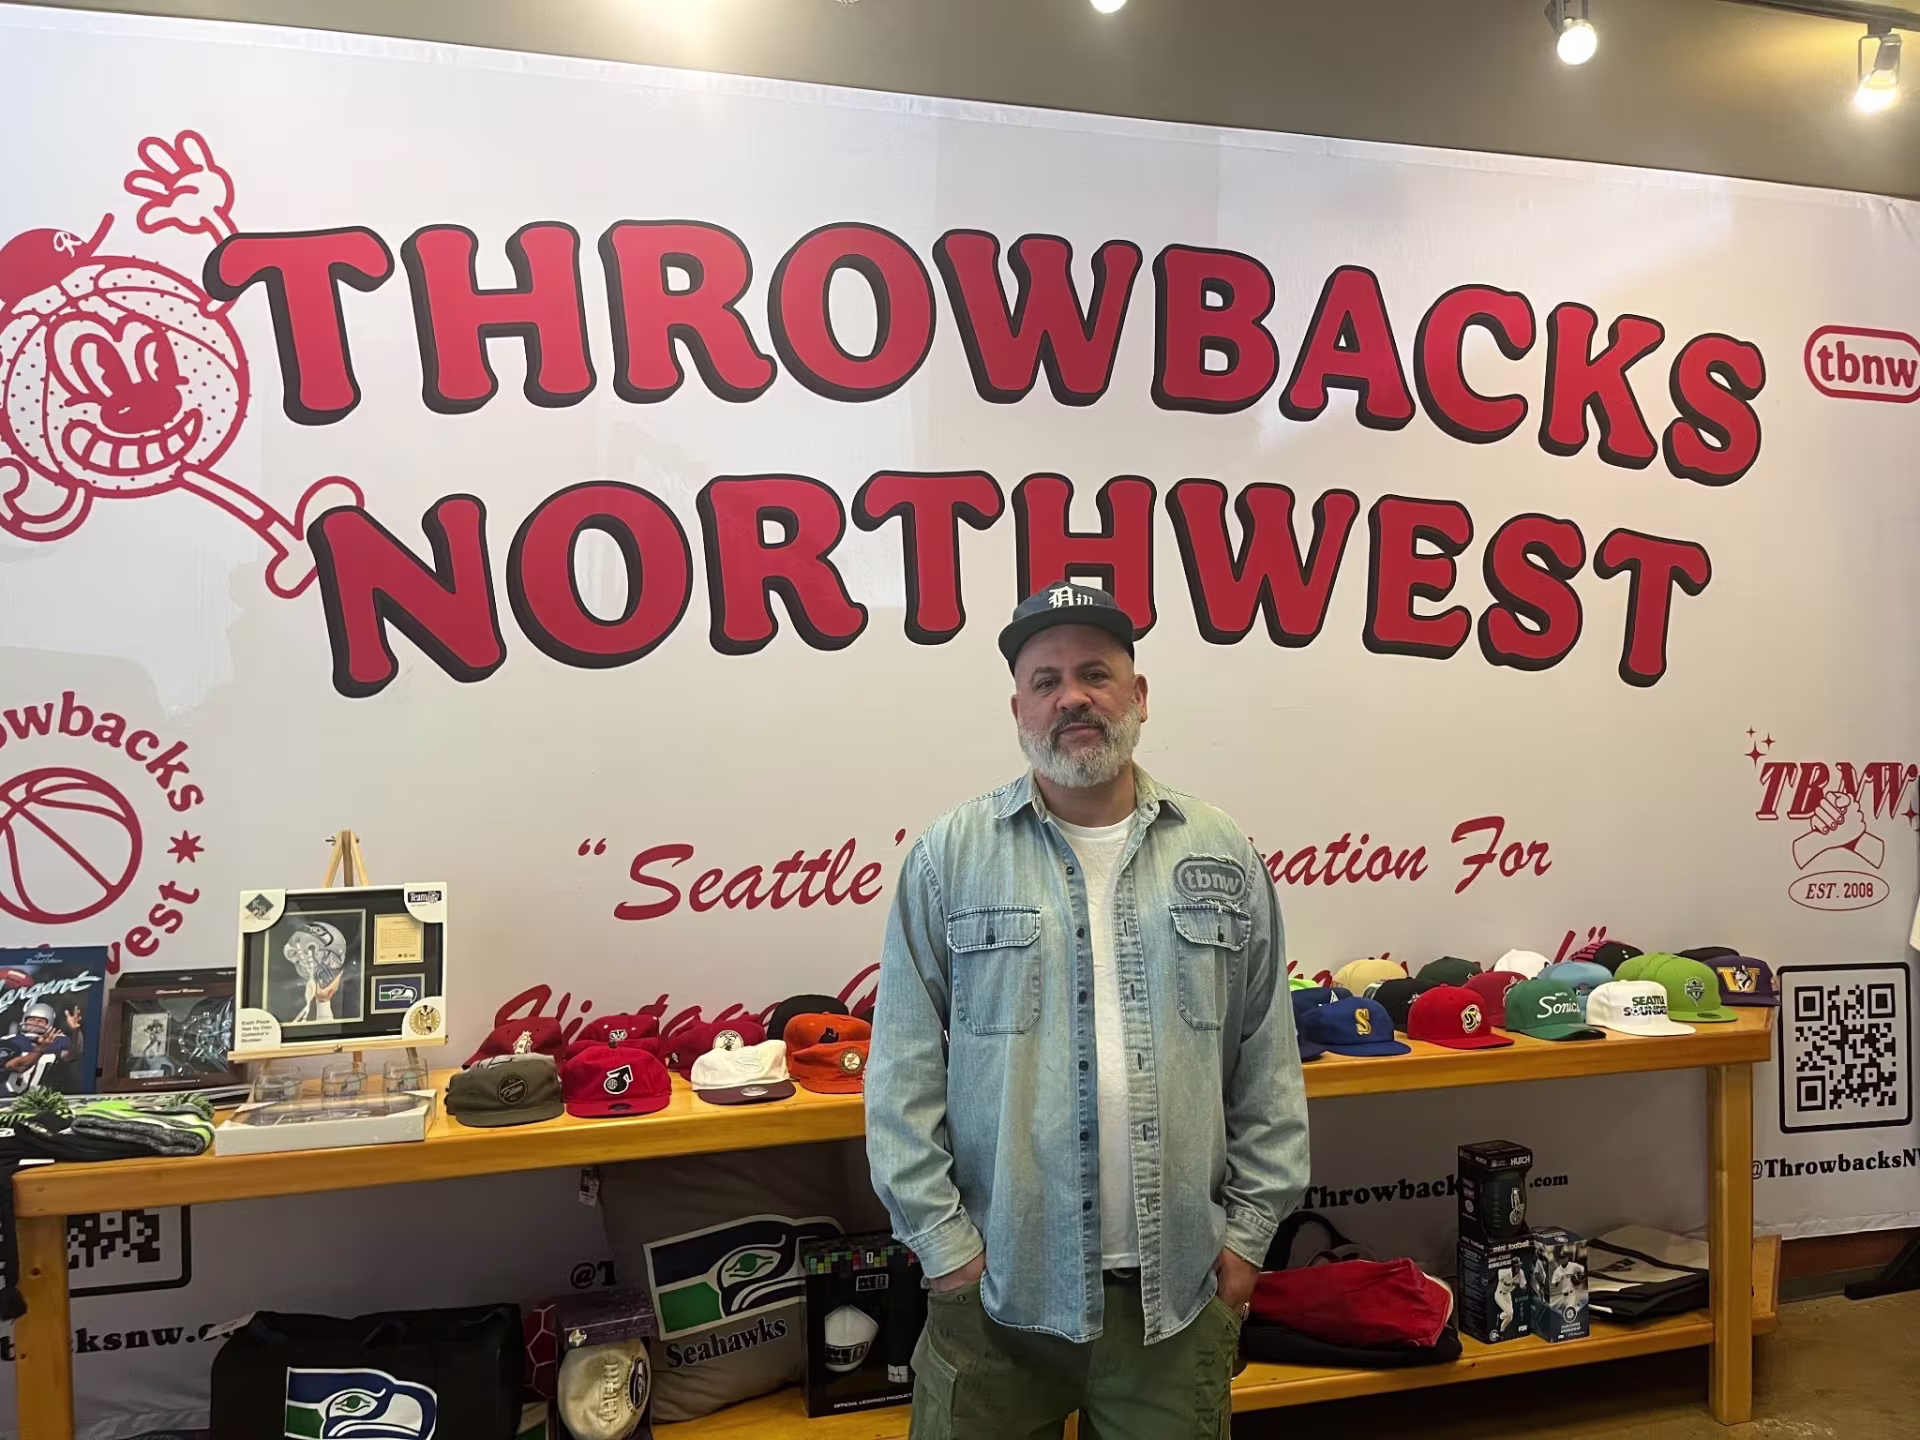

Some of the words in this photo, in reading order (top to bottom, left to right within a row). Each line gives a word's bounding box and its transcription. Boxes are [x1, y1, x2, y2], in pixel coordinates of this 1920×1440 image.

[202, 219, 1767, 487] THROWBACKS
[1817, 340, 1918, 389] tbnw
[307, 471, 1712, 700] NORTHWEST
[1184, 867, 1241, 893] tbnw
[1450, 815, 1552, 894] For
[1844, 882, 1873, 898] 2008
[1510, 1155, 1530, 1166] HUTCH
[665, 1316, 788, 1369] Seahawks
